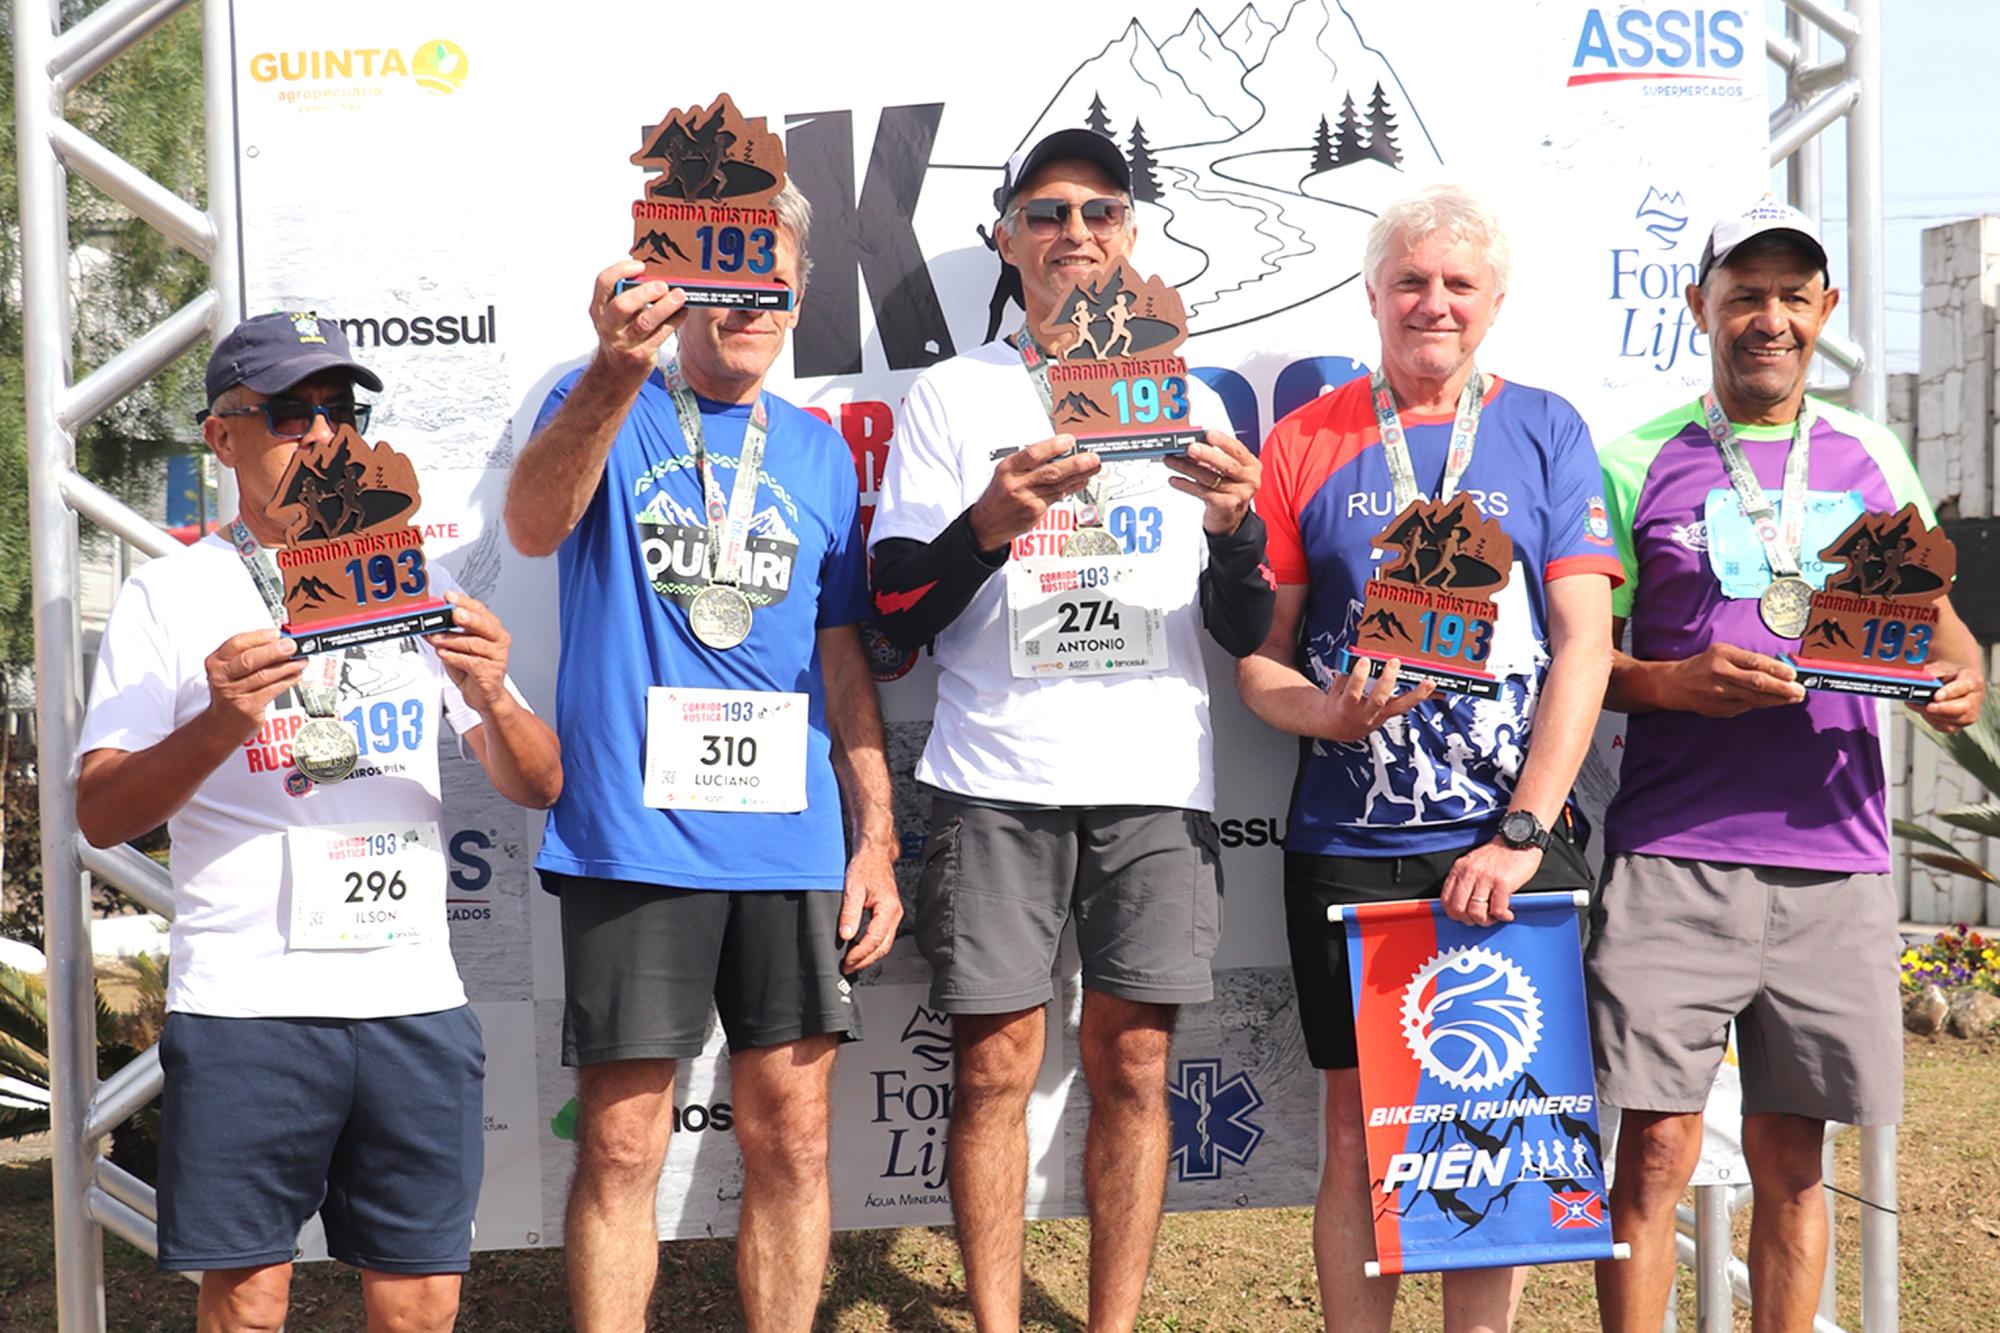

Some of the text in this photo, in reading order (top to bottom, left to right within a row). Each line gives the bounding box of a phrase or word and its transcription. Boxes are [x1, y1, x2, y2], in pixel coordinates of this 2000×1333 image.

[1573, 9, 1744, 69] ASSIS
[250, 48, 408, 83] GUINTA
[1642, 85, 1743, 97] SUPERMERCADOS
[634, 202, 778, 226] CORRIDA RÚSTICA
[696, 225, 776, 275] 193
[1608, 249, 1701, 299] Fon
[338, 305, 497, 348] mossul
[1049, 356, 1187, 384] CORRIDA RÚSTICA
[1111, 376, 1188, 425] 193
[423, 523, 459, 539] ATE
[279, 532, 423, 569] CORRIDA RÚSTICA
[345, 548, 427, 606] 193
[1039, 566, 1109, 589] CORRIDA 193
[1366, 580, 1433, 608] CORRIDA
[1812, 593, 1877, 616] CORRIDA
[1058, 600, 1121, 634] 274
[1056, 637, 1126, 654] ANTONIO
[1419, 610, 1494, 662] 193
[1862, 618, 1933, 665] 193
[343, 698, 425, 757] 193
[682, 701, 754, 722] CORRIDA 193
[700, 735, 757, 767] 310
[344, 764, 382, 781] EIROS
[695, 774, 761, 788] LUCIANO
[366, 832, 397, 857] 193
[344, 870, 407, 903] 296
[356, 910, 397, 924] ILSON
[1368, 1103, 1458, 1127] BIKERS
[1472, 1095, 1593, 1121] RUNNERS
[1381, 1142, 1512, 1194] PIÊN
